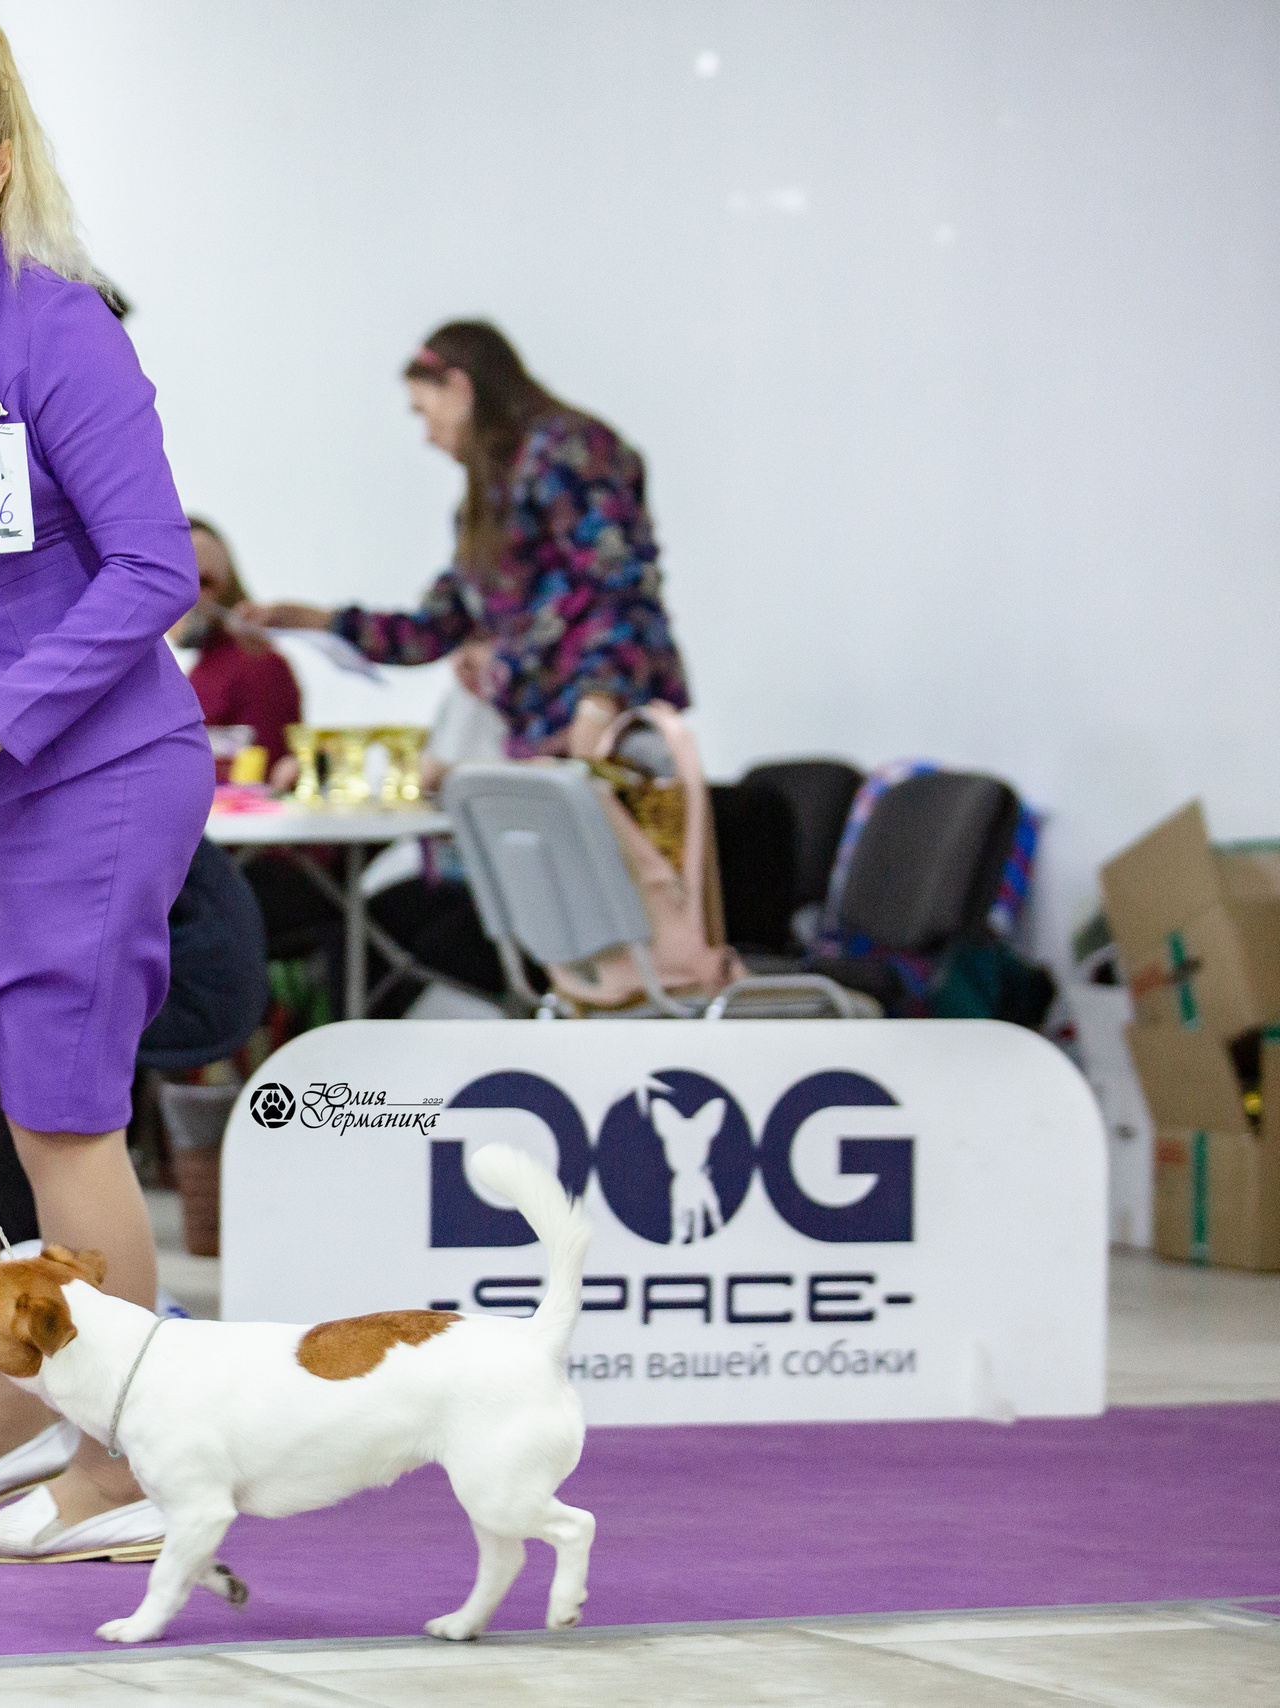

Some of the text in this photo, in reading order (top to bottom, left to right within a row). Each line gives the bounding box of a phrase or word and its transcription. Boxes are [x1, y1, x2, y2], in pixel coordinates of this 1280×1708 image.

[429, 1068, 917, 1248] DOG
[567, 1338, 917, 1379] ная вашей собаки
